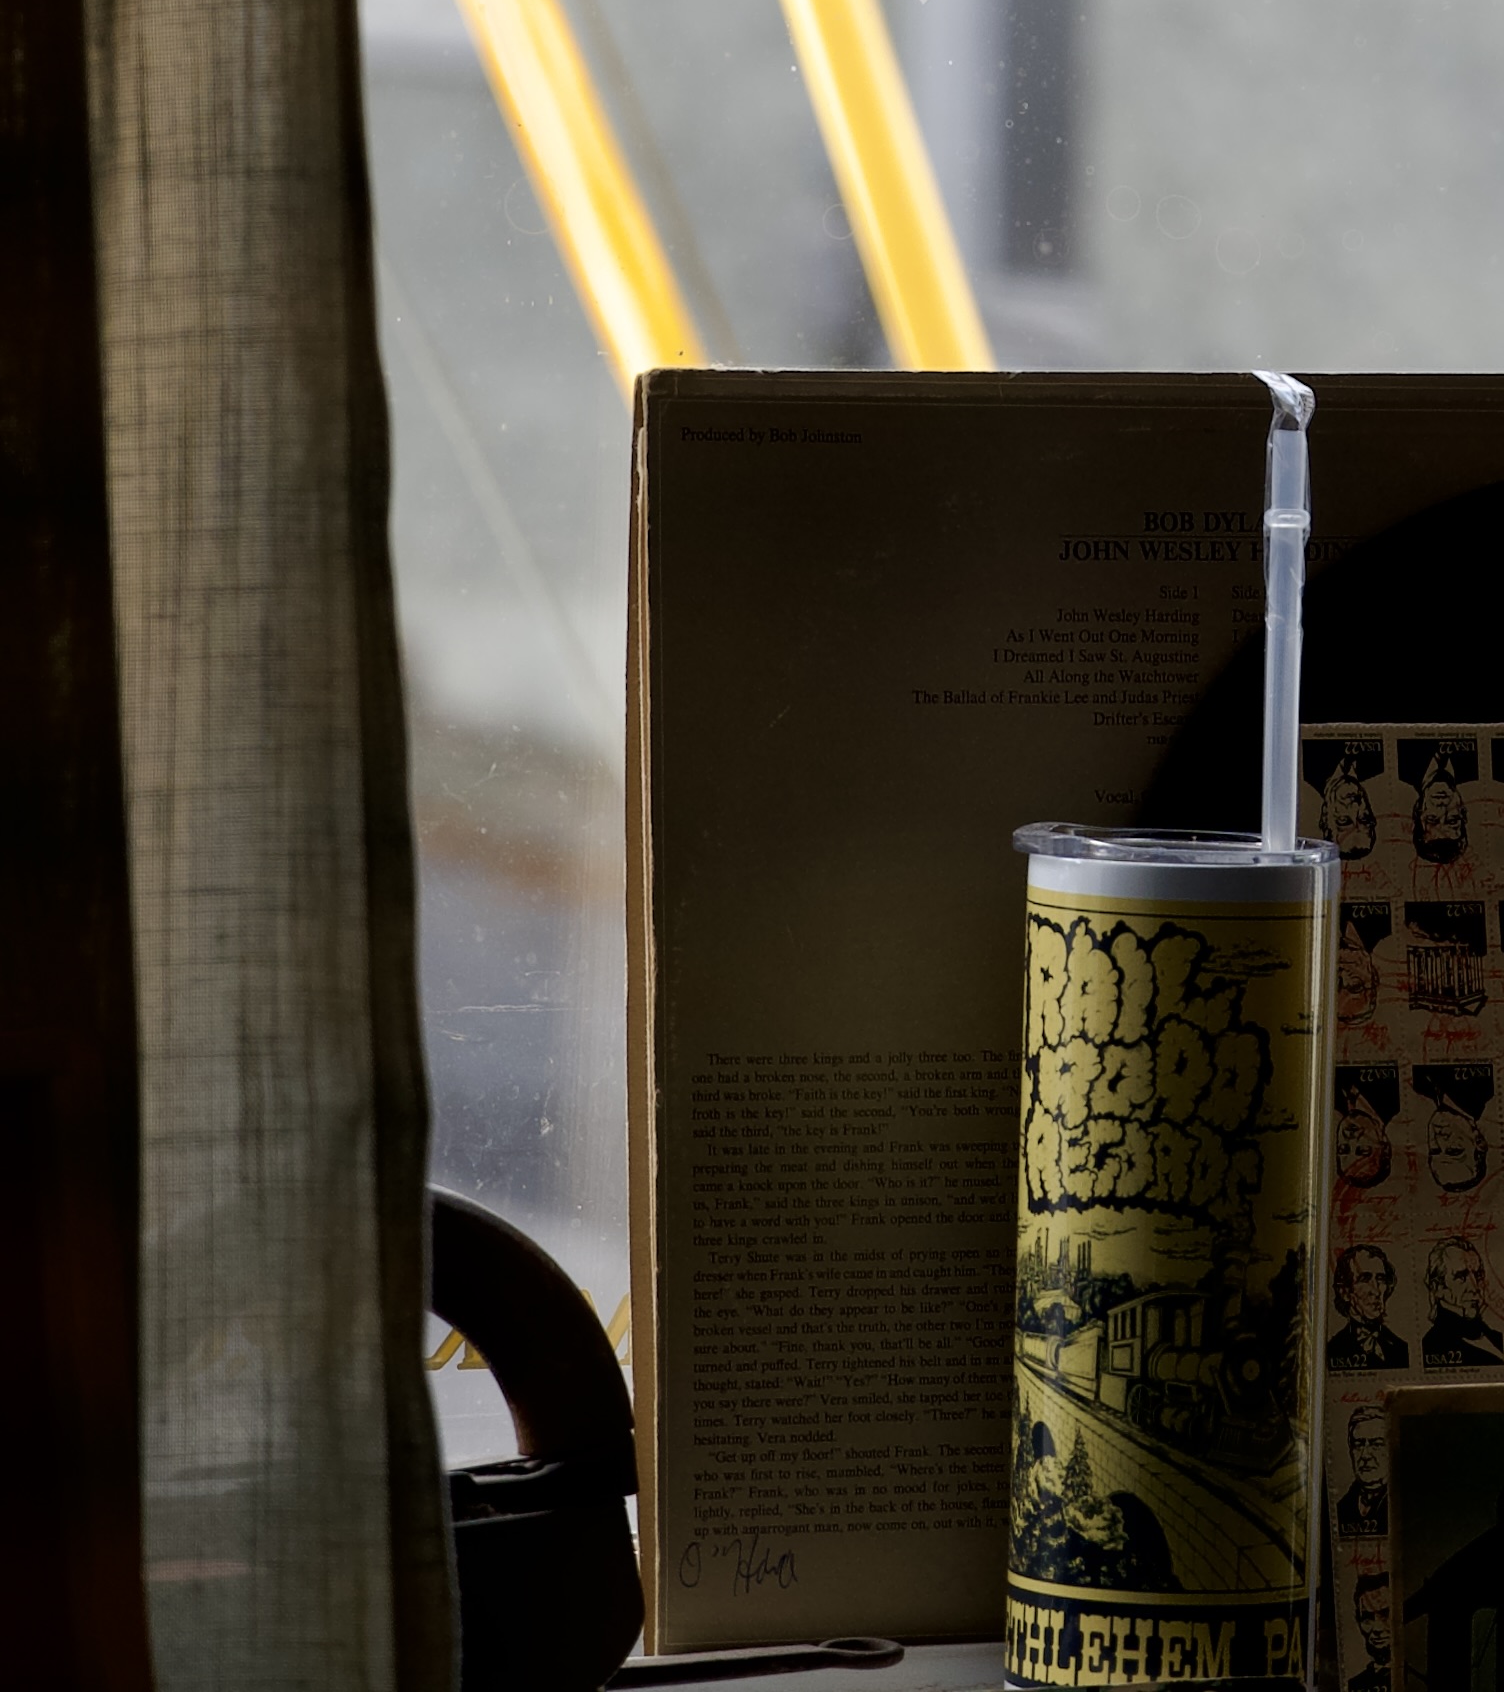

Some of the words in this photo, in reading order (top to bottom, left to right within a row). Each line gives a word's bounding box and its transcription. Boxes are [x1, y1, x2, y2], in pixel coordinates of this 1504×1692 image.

[681, 427, 745, 444] Produced
[748, 428, 767, 447] by
[769, 428, 797, 443] Bob
[802, 427, 862, 445] Johnston
[1143, 511, 1195, 533] BOB
[1059, 540, 1130, 561] JOHN
[1139, 539, 1241, 562] WESLEY
[1159, 585, 1189, 600] Side
[1191, 585, 1199, 600] 1
[1230, 585, 1260, 601] Side
[1057, 608, 1089, 624] John
[1093, 609, 1140, 627] Wesley
[1144, 609, 1200, 627] Harding
[1006, 629, 1025, 643] As
[1029, 629, 1034, 643] I
[1038, 629, 1075, 644] Went
[1078, 629, 1105, 644] Out
[1108, 629, 1137, 644] One
[1141, 629, 1199, 646] Morning
[994, 649, 998, 663] I
[1003, 649, 1065, 664] Dreamed
[1069, 649, 1075, 663] I
[1078, 649, 1106, 663] Saw
[1110, 649, 1128, 663] St.
[1133, 649, 1200, 666] Augustine
[1023, 669, 1044, 684] All
[1048, 669, 1090, 687] Along
[1094, 669, 1115, 684] the
[1118, 669, 1200, 685] Watchtower
[912, 690, 939, 704] The
[943, 690, 986, 705] Ballad
[990, 690, 1004, 705] of
[1008, 690, 1061, 705] Frankie
[1064, 690, 1090, 705] Lee
[1093, 690, 1117, 705] and
[1120, 690, 1159, 705] Judas
[1162, 690, 1201, 707] Priest
[1093, 710, 1148, 726] Drifter's
[1094, 788, 1139, 804] Vocal,
[708, 1054, 741, 1066] There
[746, 1056, 774, 1066] were
[780, 1053, 808, 1065] three
[813, 1053, 844, 1068] kings
[849, 1052, 870, 1064] and
[875, 1055, 882, 1063] a
[887, 1051, 915, 1067] jolly
[918, 1051, 948, 1064] three
[952, 1052, 976, 1064] too.
[980, 1049, 1003, 1062] The
[693, 1126, 716, 1140] said
[720, 1126, 738, 1138] the
[742, 1125, 774, 1140] third,
[806, 1124, 826, 1140] key
[830, 1124, 839, 1136] is
[743, 1451, 757, 1466] up
[760, 1449, 777, 1462] off
[781, 1450, 800, 1465] my
[846, 1446, 890, 1460] shouted
[895, 1445, 933, 1458] Frank.
[938, 1444, 962, 1457] The
[965, 1443, 1004, 1457] second
[1005, 1595, 1236, 1687] THLEHEM
